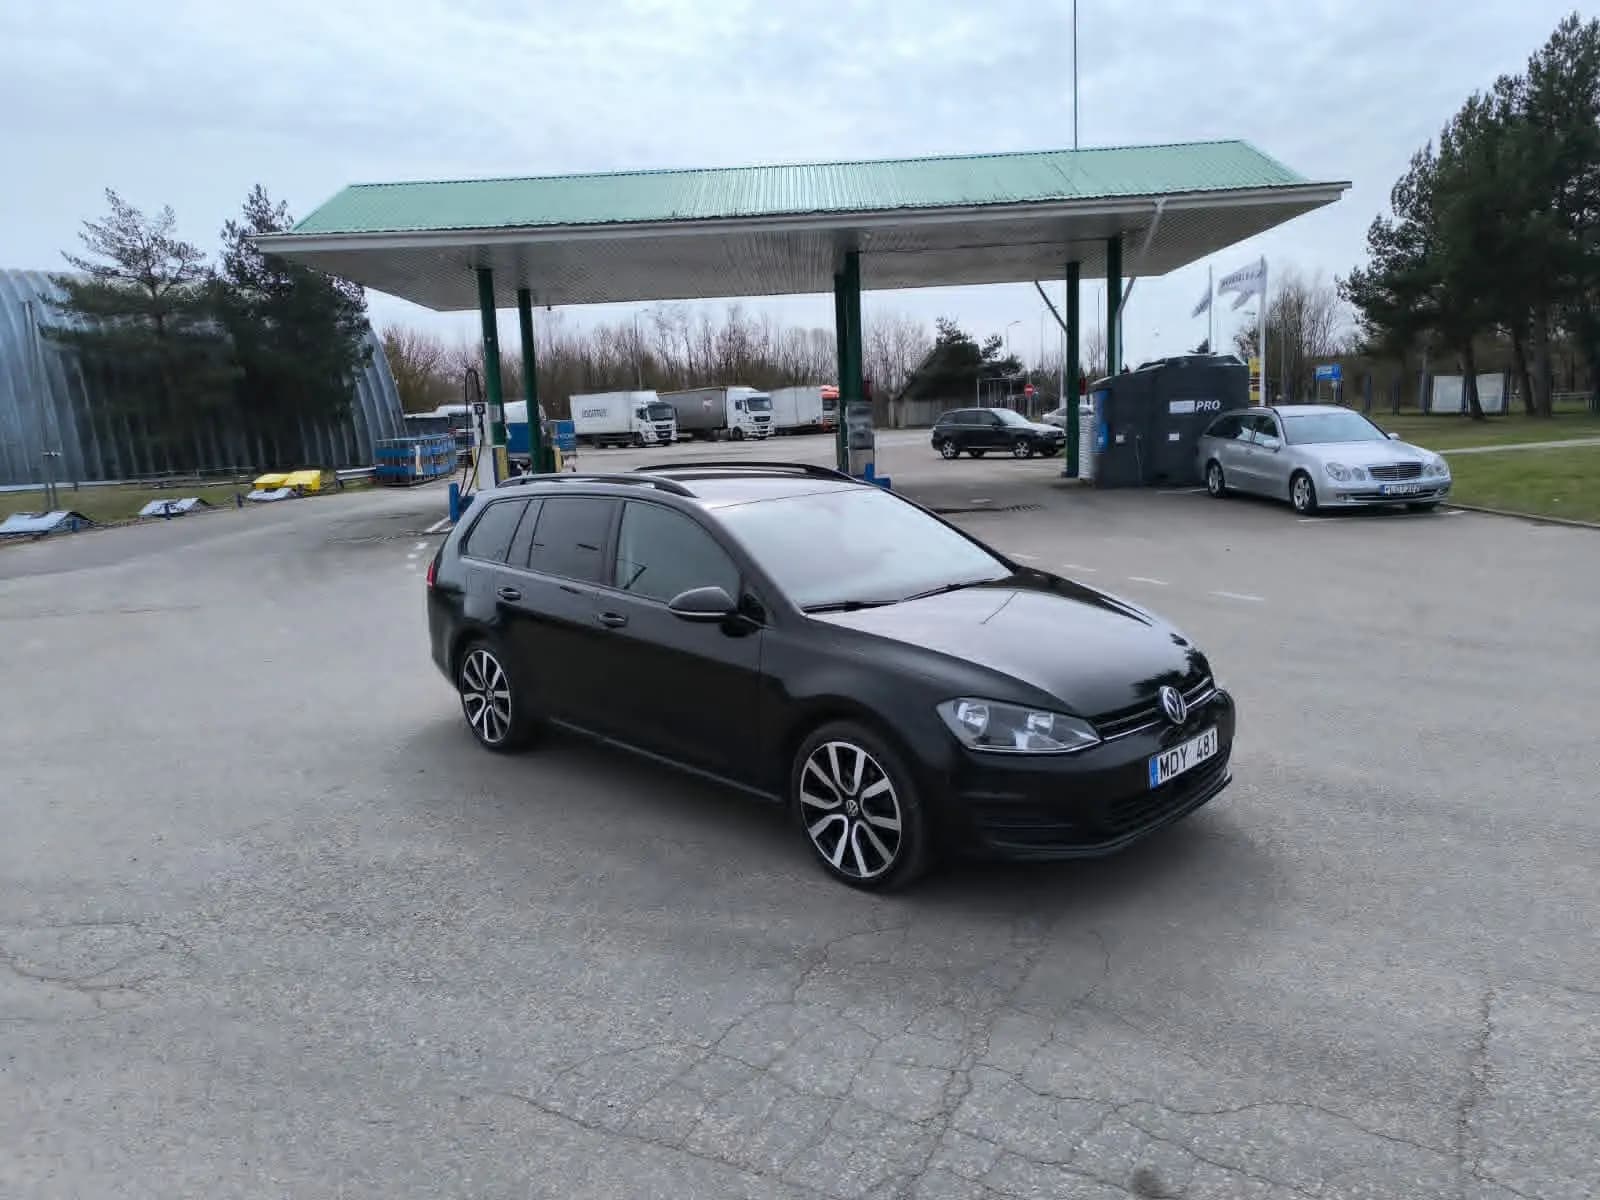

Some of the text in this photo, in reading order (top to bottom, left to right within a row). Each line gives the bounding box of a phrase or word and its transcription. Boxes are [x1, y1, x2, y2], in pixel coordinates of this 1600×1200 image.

[1195, 400, 1221, 412] PRO
[1159, 730, 1215, 780] MDY 481
